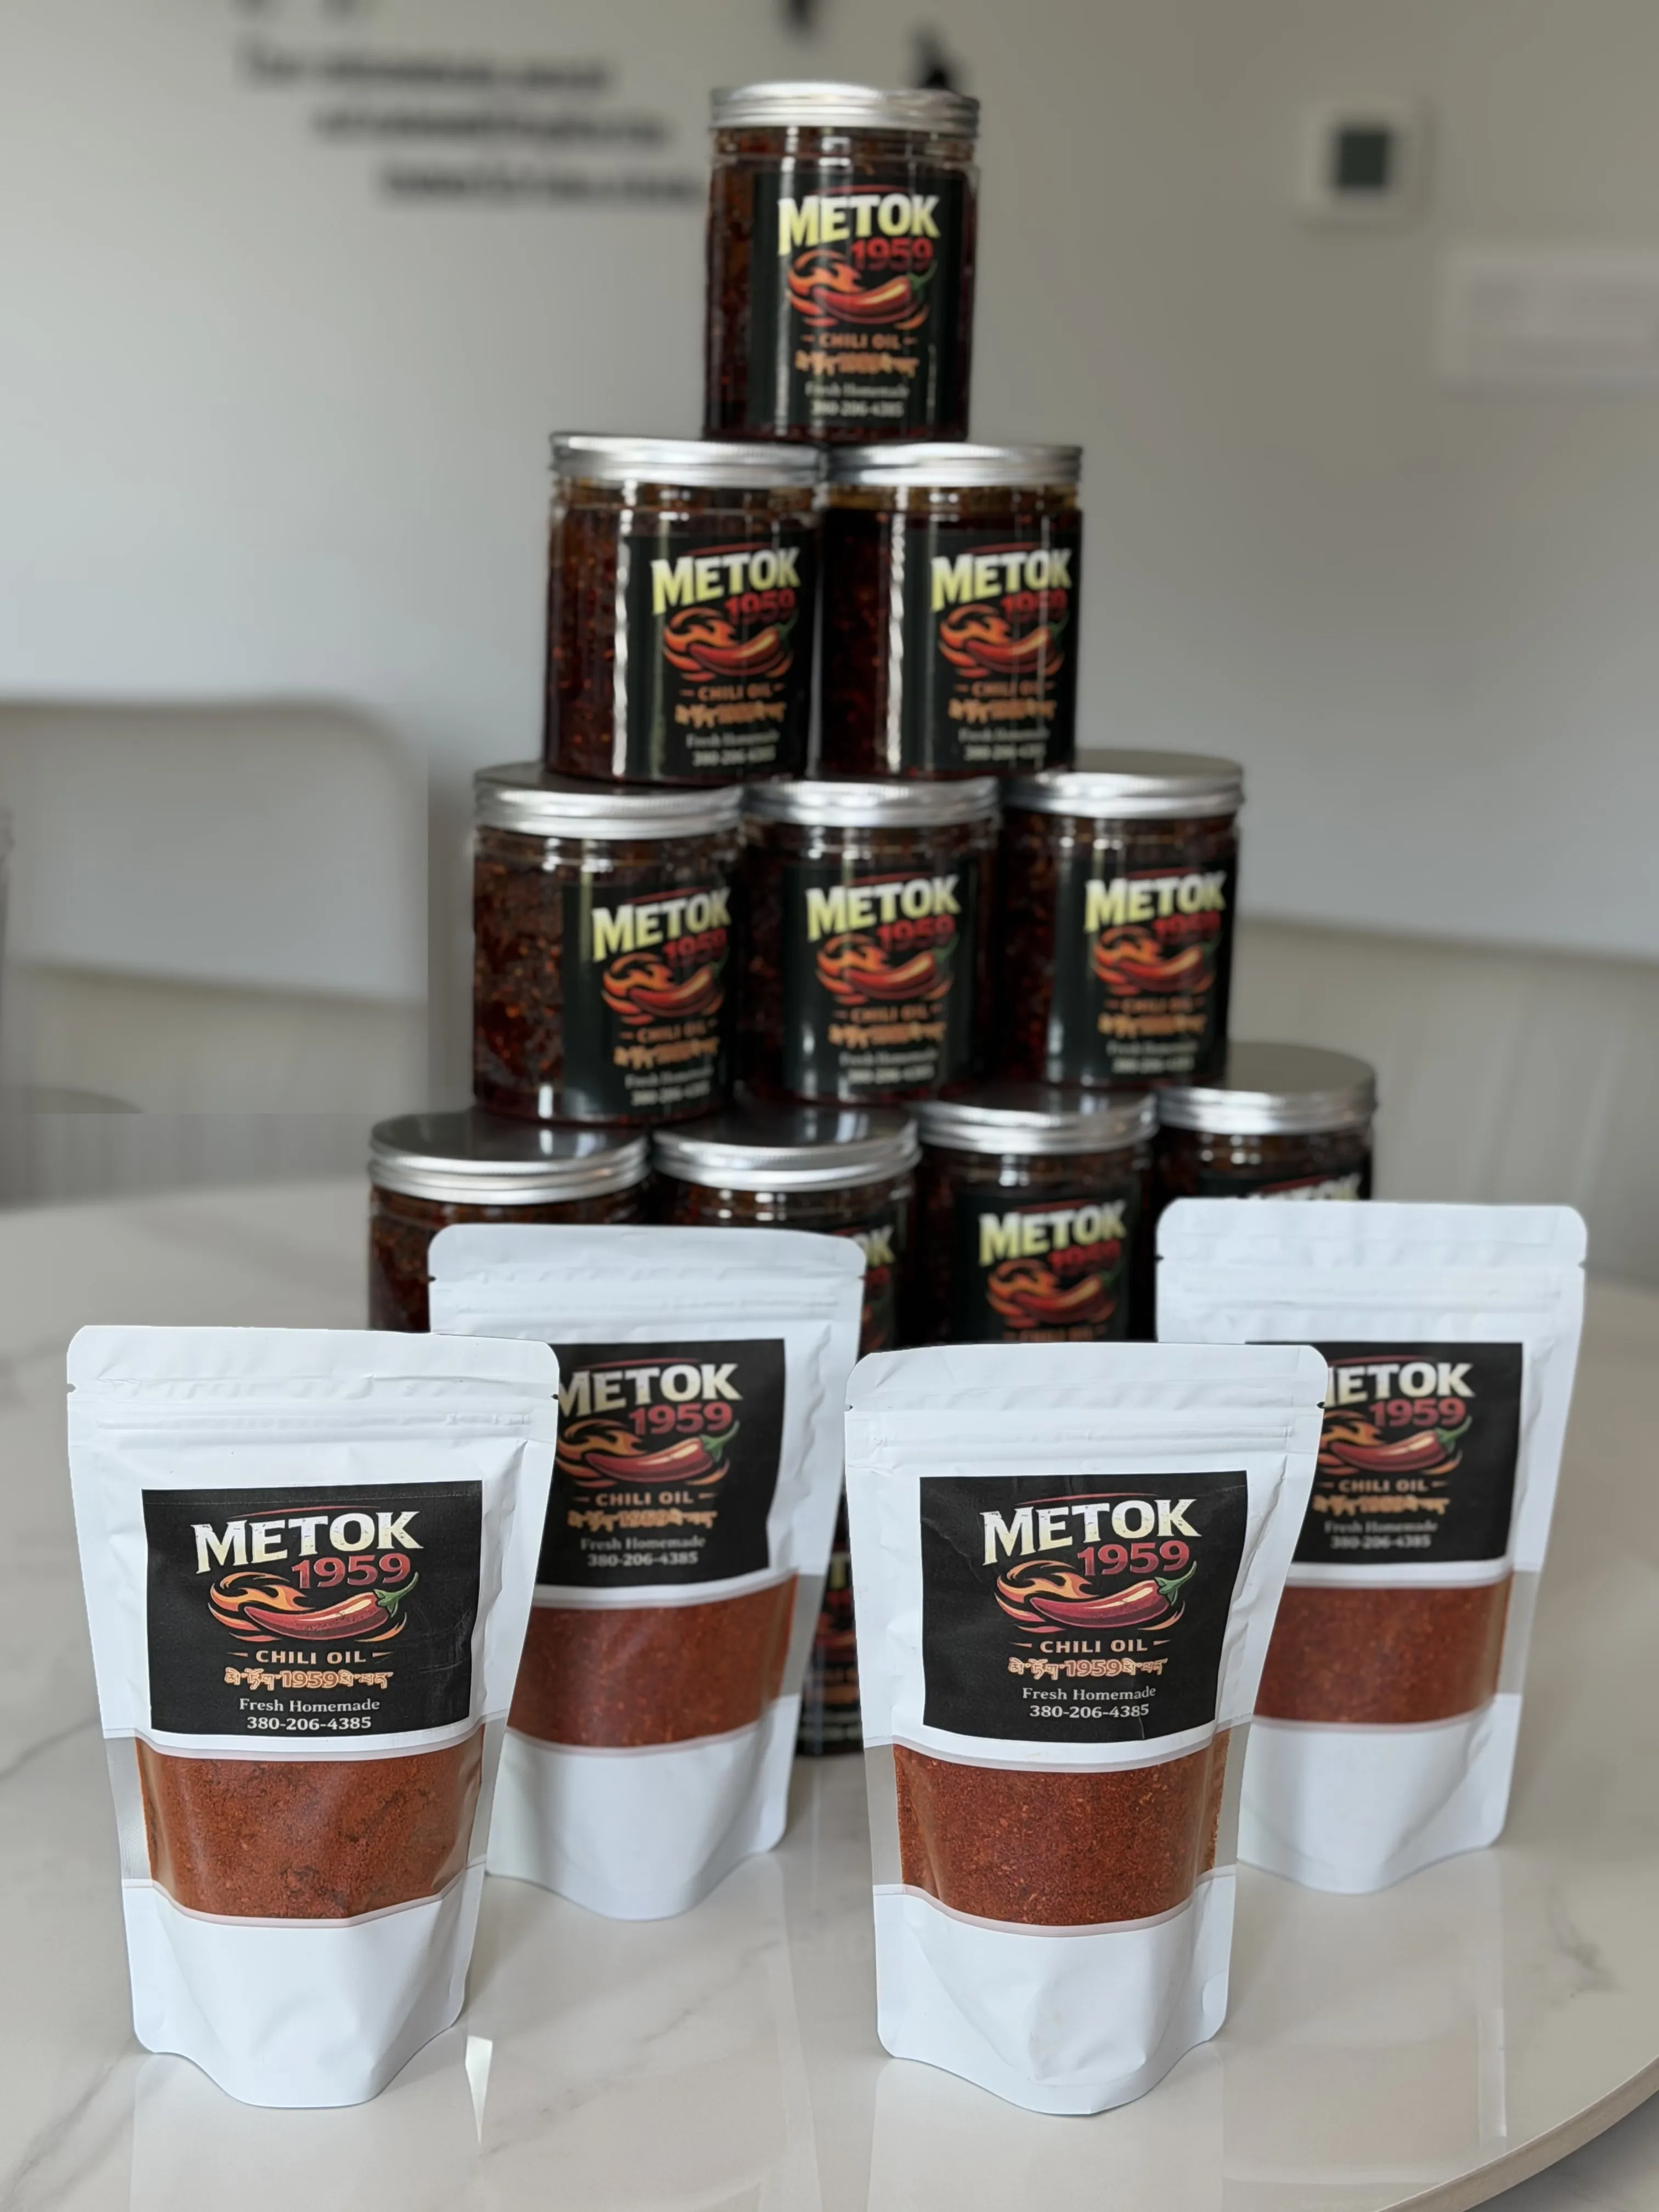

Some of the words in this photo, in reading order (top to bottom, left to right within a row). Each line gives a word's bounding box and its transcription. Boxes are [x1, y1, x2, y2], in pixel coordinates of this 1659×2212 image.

[777, 193, 941, 256] METOK
[851, 238, 933, 271] 1959
[819, 332, 868, 348] CHILI
[872, 332, 901, 350] OIL
[650, 546, 800, 616] METOK
[931, 548, 1072, 612] METOK
[725, 589, 795, 625] 1959
[805, 874, 961, 942] METOK
[1084, 870, 1226, 933] METOK
[592, 887, 731, 962] METOK
[978, 1199, 1127, 1267] METOK
[558, 1363, 743, 1418] METOK
[629, 1401, 732, 1435] 1959
[1369, 1397, 1466, 1427] 1959
[595, 1492, 651, 1506] CHILI
[658, 1491, 694, 1505] OIL
[1339, 1480, 1390, 1493] CHILI
[1396, 1479, 1429, 1492] OIL
[190, 1511, 424, 1574] METOK
[580, 1538, 621, 1551] Fresh
[626, 1534, 706, 1549] Homemade
[980, 1499, 1202, 1566] METOK
[291, 1553, 411, 1588] 1959
[1077, 1541, 1190, 1576] 1959
[255, 1650, 317, 1664] CHILI
[327, 1650, 366, 1664] OIL
[1040, 1640, 1101, 1654] CHILI
[1111, 1639, 1148, 1652] OIL
[239, 1699, 284, 1712] Fresh
[289, 1699, 380, 1712] Homemade
[1023, 1688, 1067, 1700] Fresh
[1073, 1686, 1156, 1700] Homemade
[246, 1717, 371, 1731] 380-206-4385
[1030, 1704, 1149, 1718] 380-206-4385
